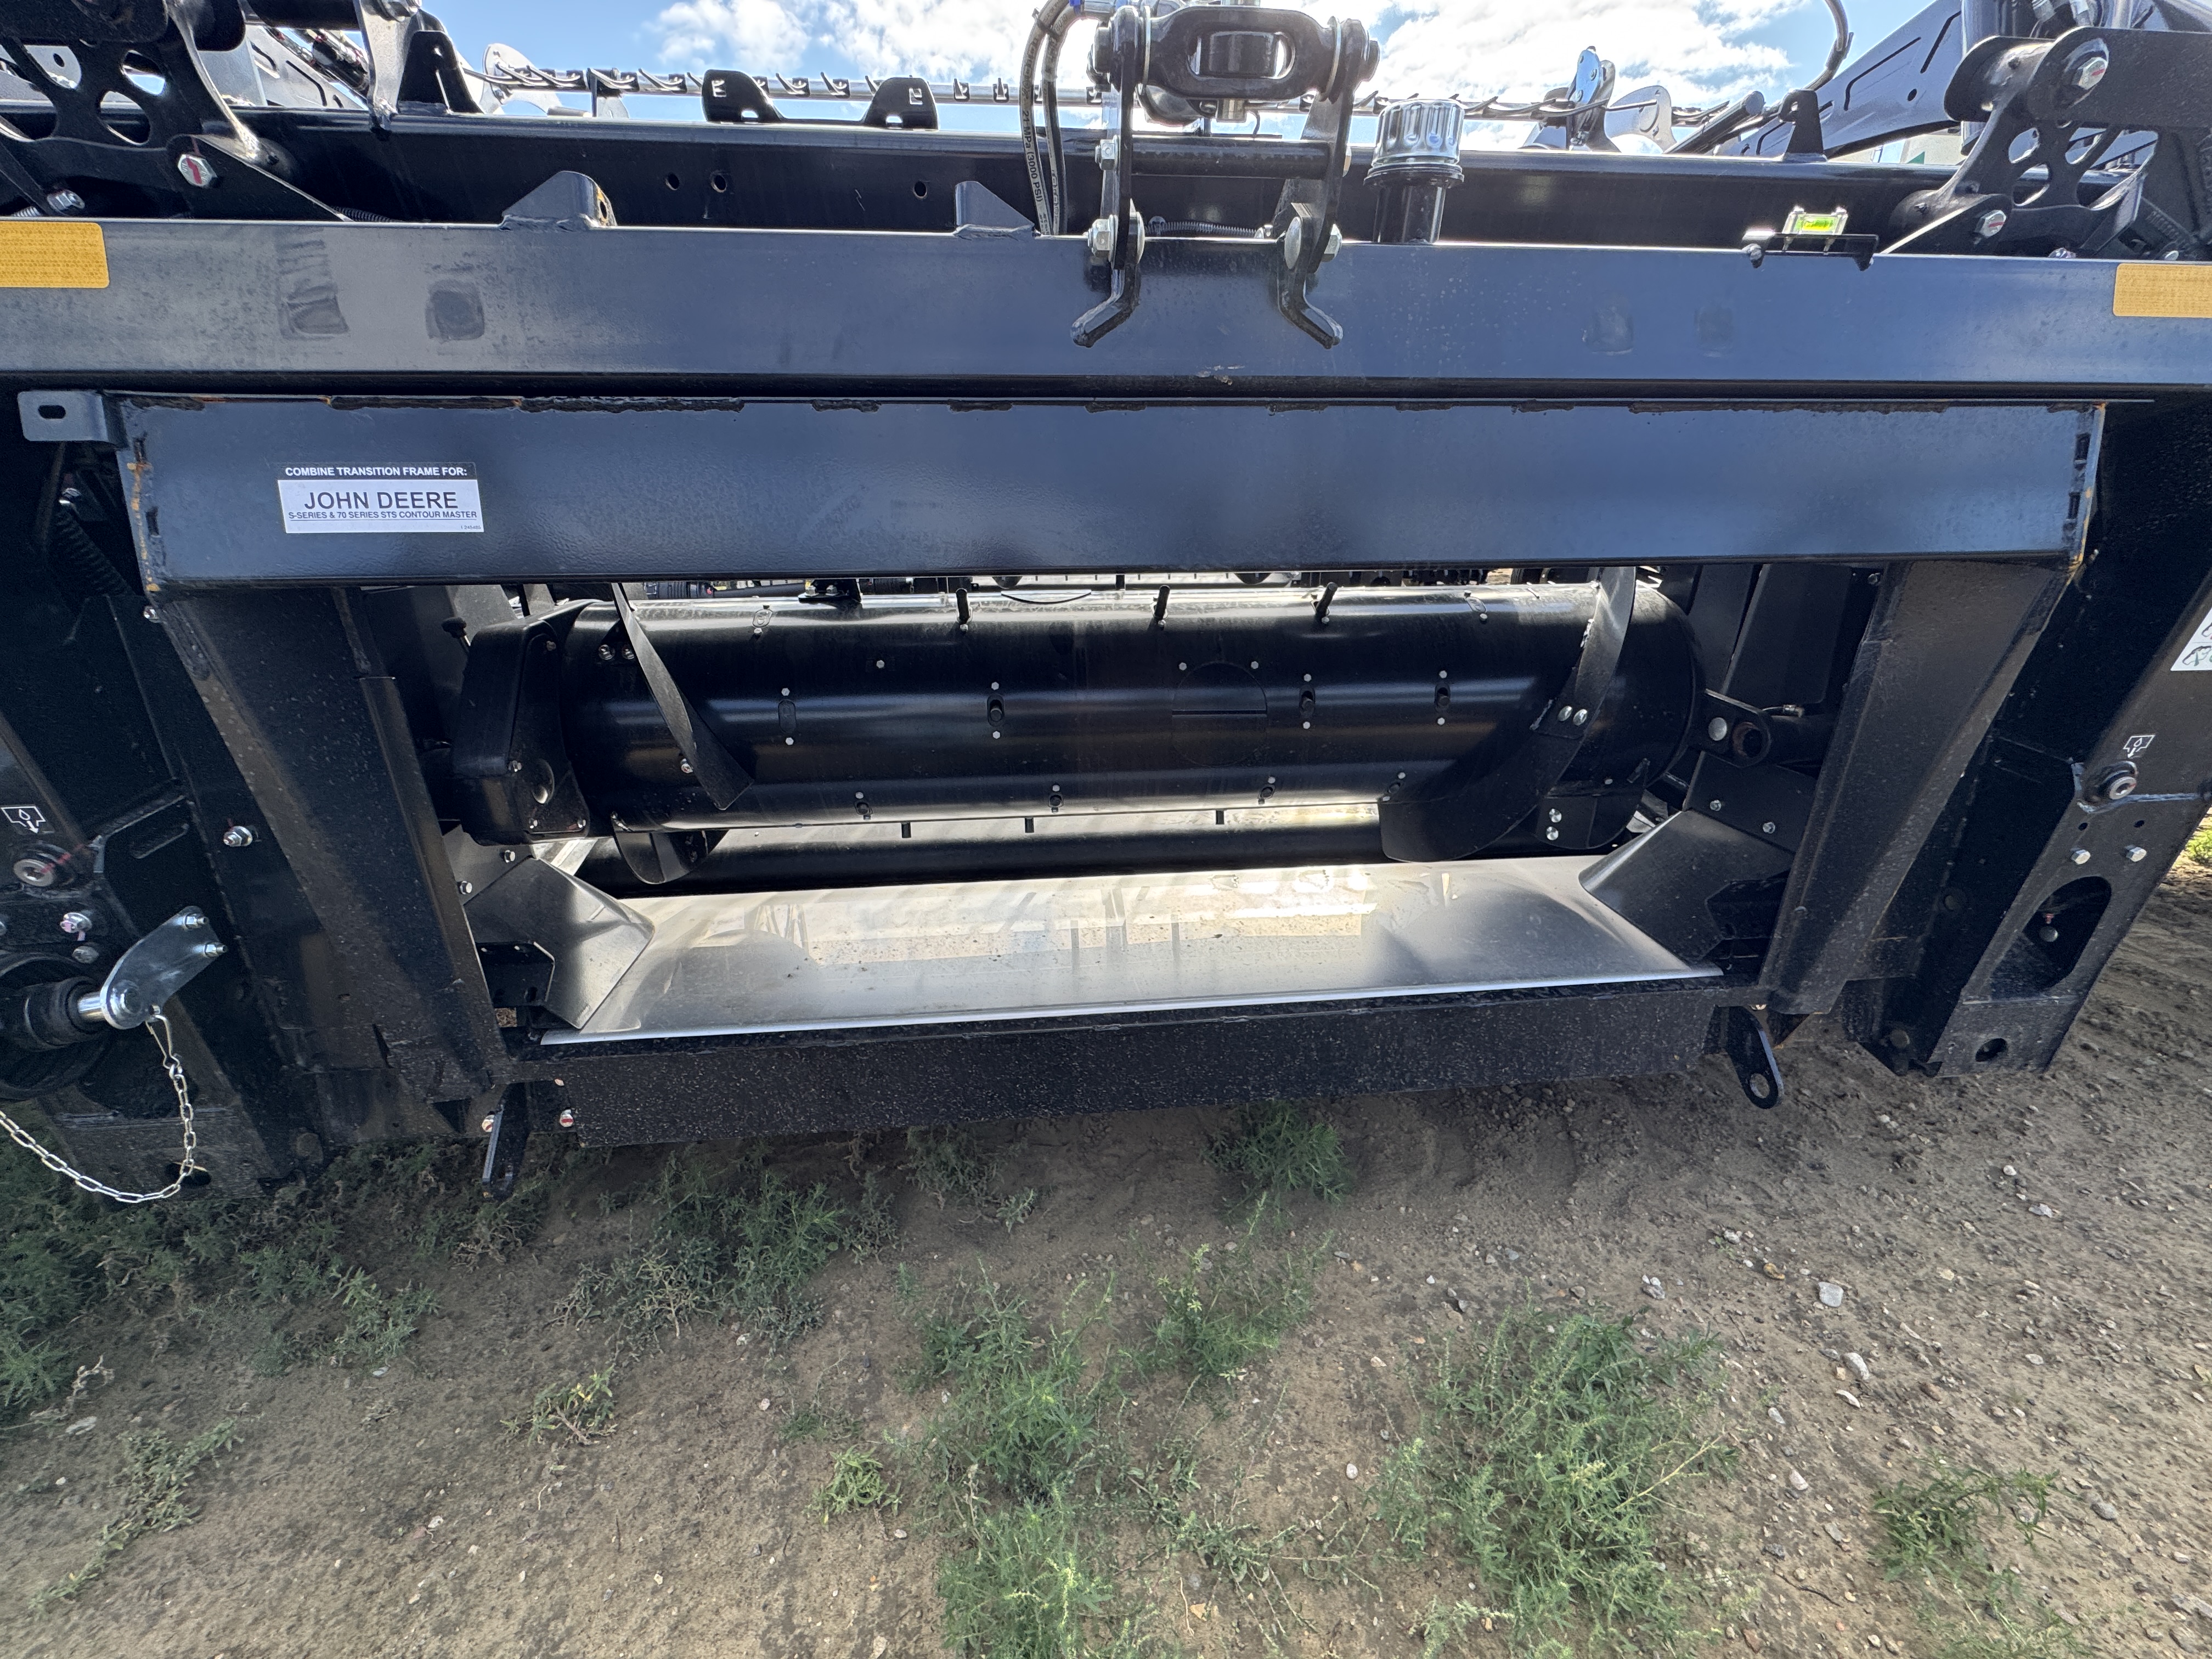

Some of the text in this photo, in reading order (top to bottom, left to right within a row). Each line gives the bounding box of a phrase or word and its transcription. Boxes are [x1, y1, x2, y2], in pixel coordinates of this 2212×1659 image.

[1027, 151, 1038, 179] (3000
[1033, 181, 1043, 202] PSI)
[285, 467, 467, 476] COMBINE TRANSITION FRAME FOR:
[304, 492, 459, 510] JOHN DEERE
